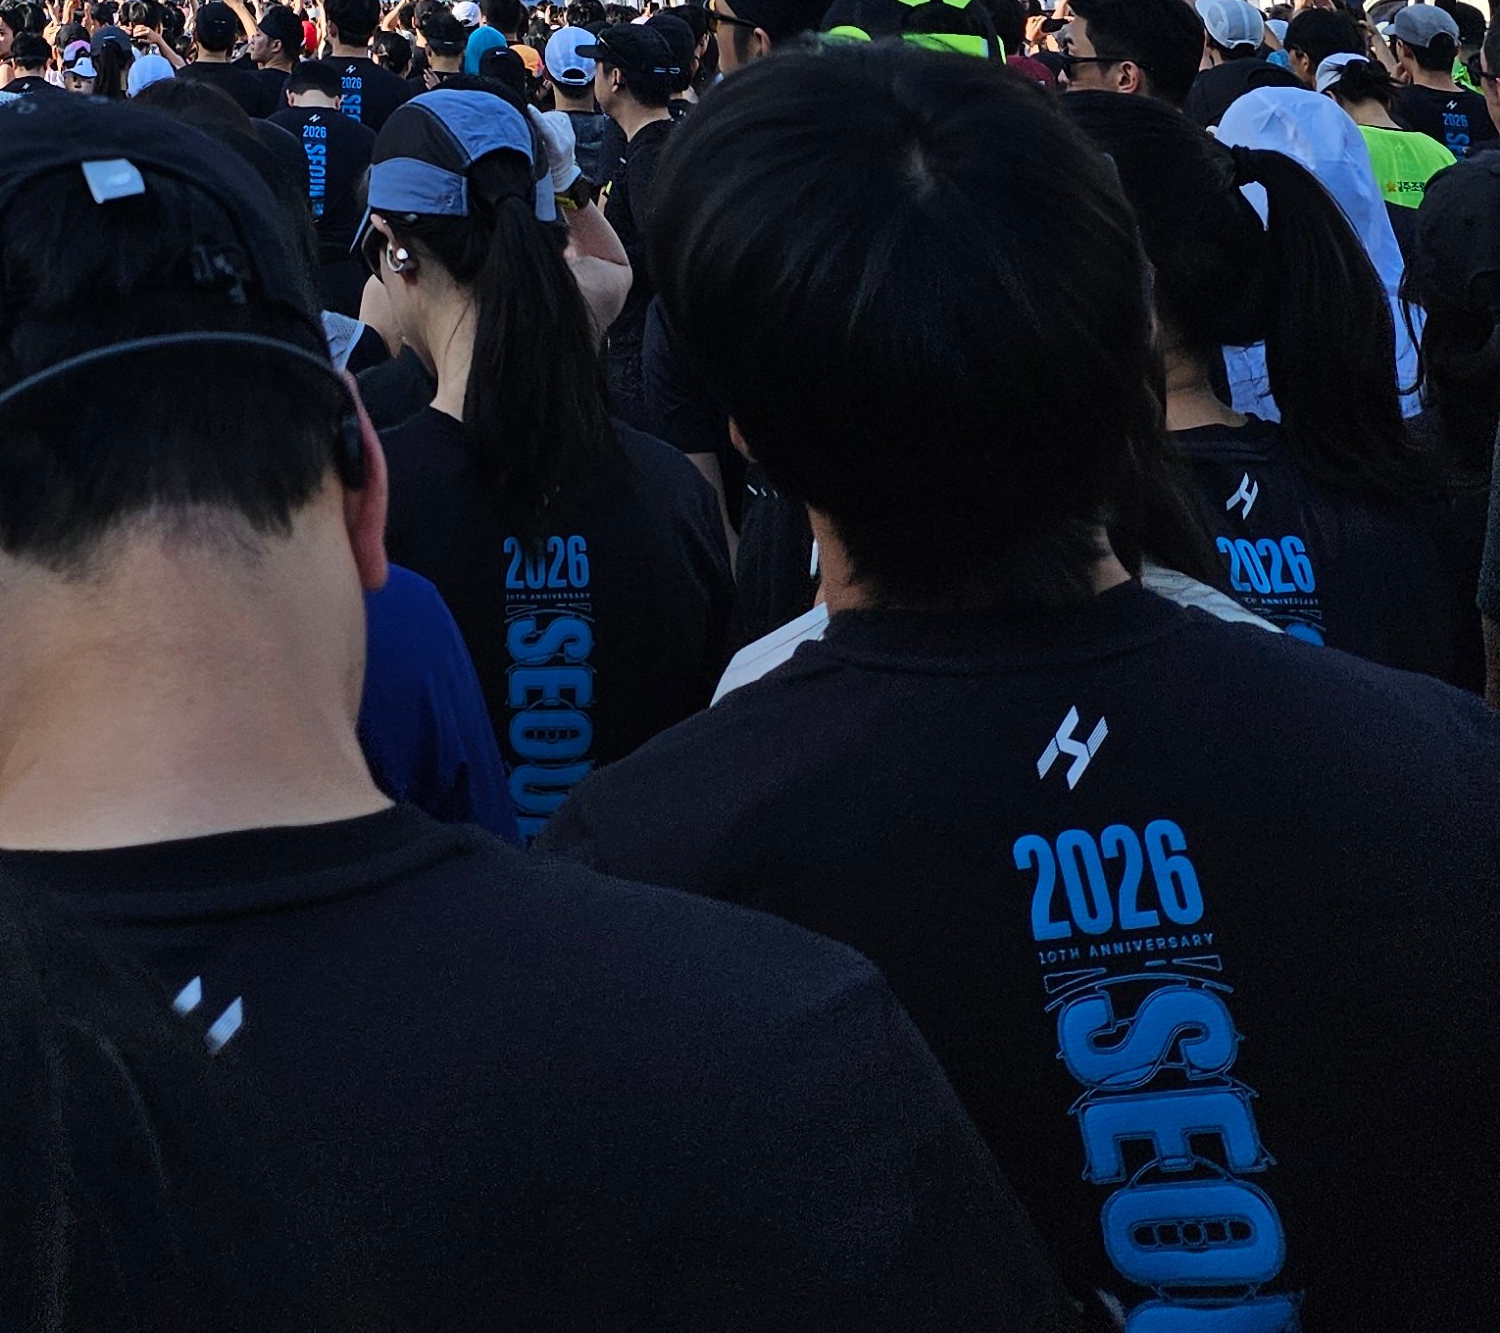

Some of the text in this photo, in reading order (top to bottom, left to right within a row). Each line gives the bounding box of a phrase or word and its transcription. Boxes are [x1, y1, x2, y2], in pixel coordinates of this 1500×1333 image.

[341, 77, 362, 89] 2026
[303, 125, 327, 138] 2026
[1442, 113, 1468, 128] 2026
[503, 535, 590, 589] 2026
[1216, 536, 1315, 594] 2026
[530, 592, 591, 600] ANNIVERSARY
[1013, 819, 1204, 941] 2026
[1038, 933, 1214, 965] 10TH ANNIVERSARY
